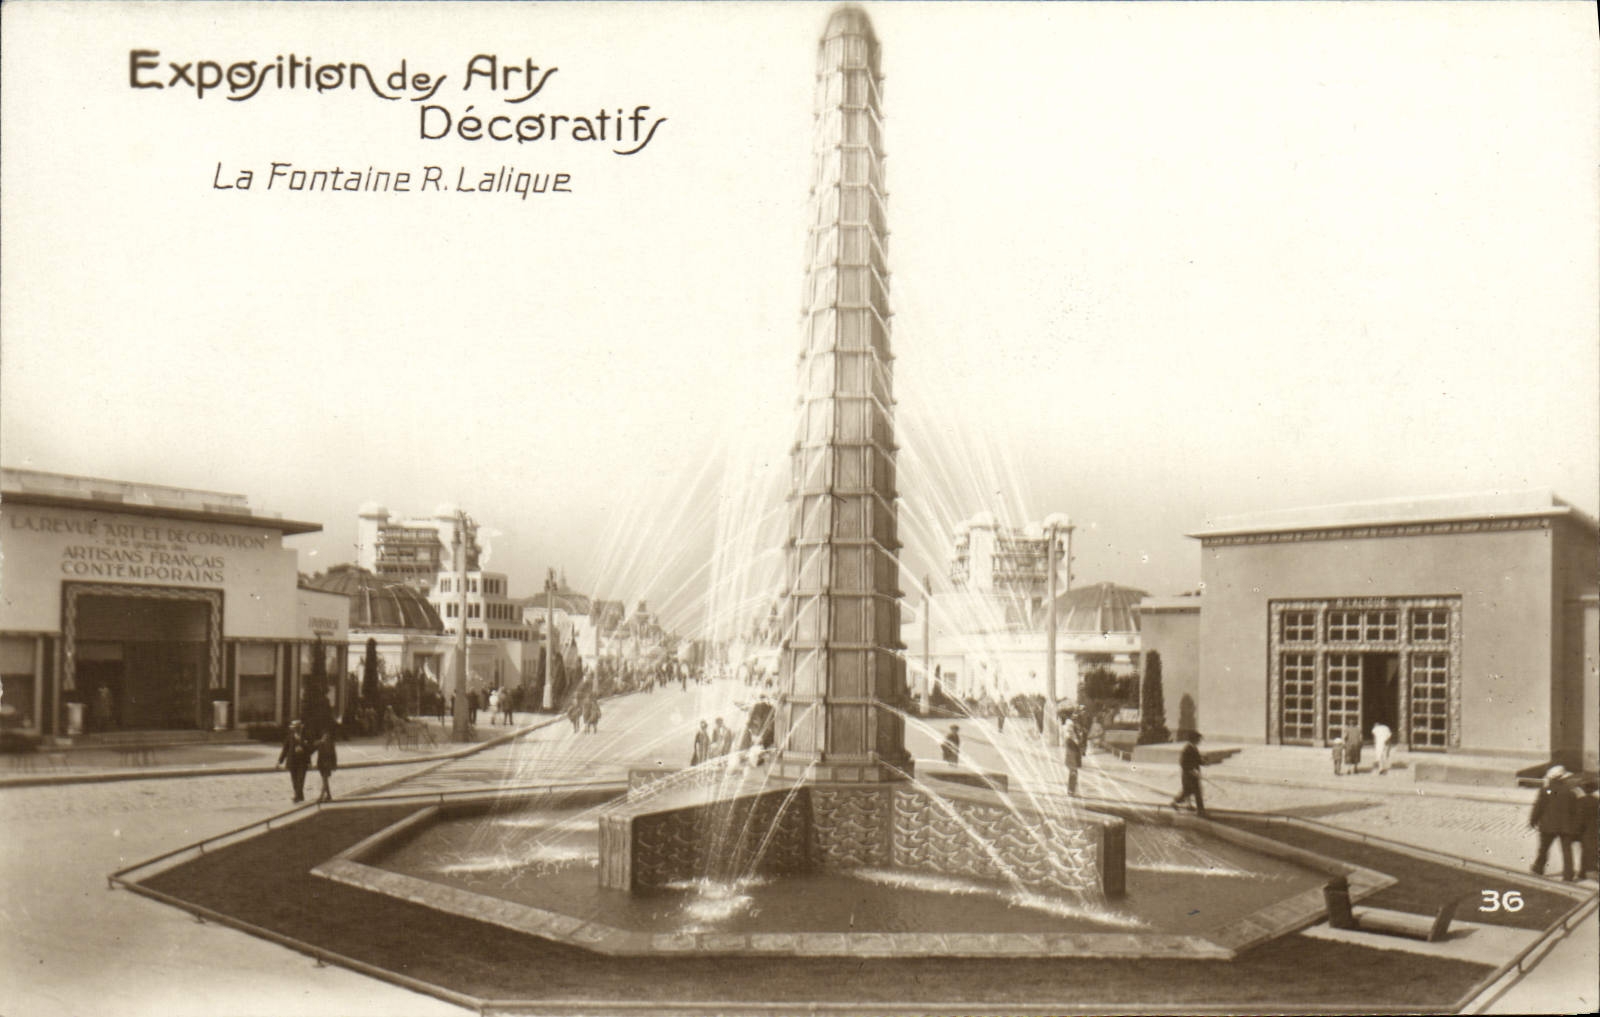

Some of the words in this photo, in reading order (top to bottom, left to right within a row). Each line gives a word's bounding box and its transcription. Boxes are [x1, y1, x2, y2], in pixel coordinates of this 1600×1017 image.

[39, 516, 98, 535] REVUE
[143, 527, 161, 541] ET
[62, 546, 144, 564] ARTISANS
[150, 550, 225, 569] FRANÇAIS
[61, 560, 225, 583] CONTEMPORAINS
